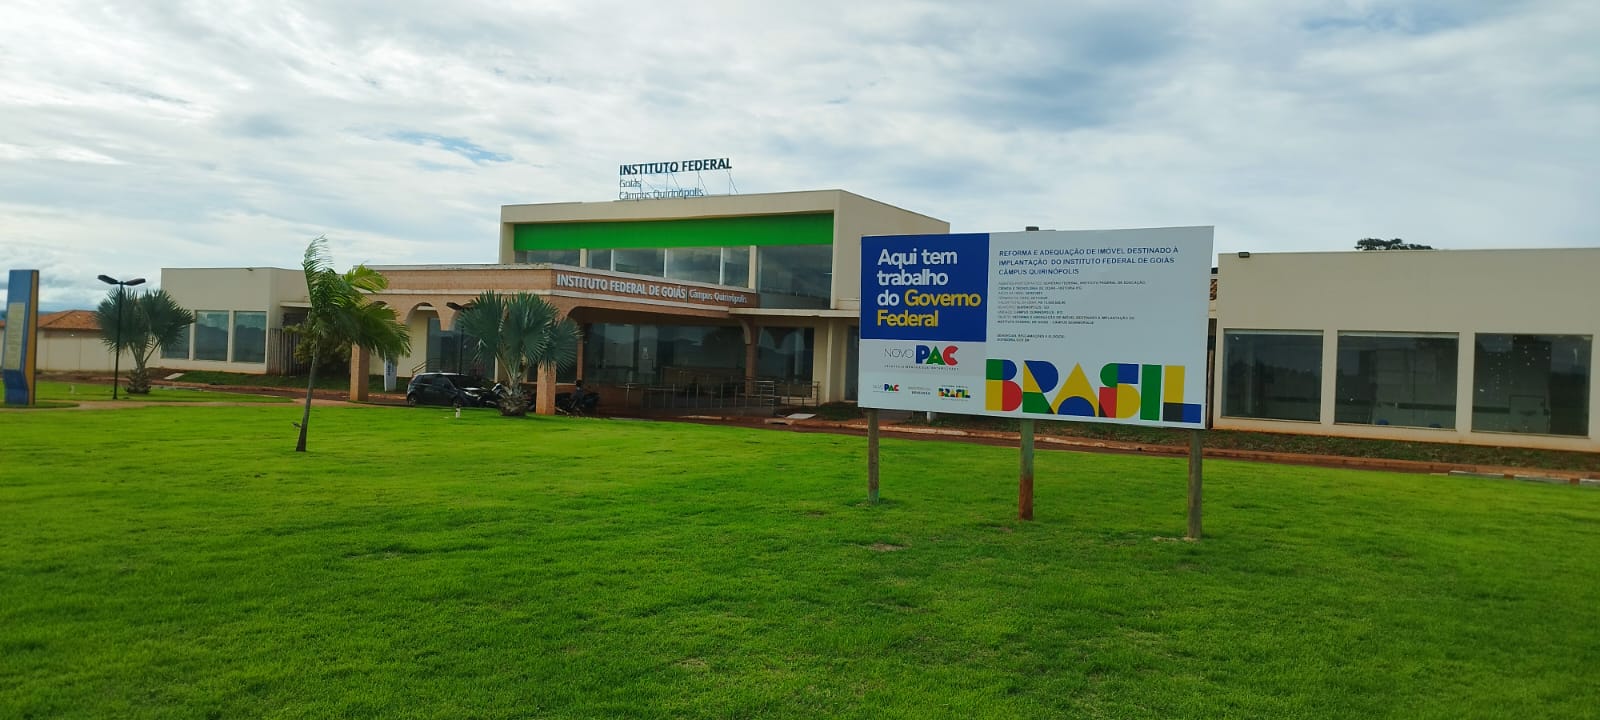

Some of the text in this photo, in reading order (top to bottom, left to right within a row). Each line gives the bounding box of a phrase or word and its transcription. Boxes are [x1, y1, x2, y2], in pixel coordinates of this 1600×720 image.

[619, 158, 732, 175] INSTITUTO FEDERAL
[877, 248, 958, 270] Aqui tem
[1039, 248, 1085, 256] ADEQUAÇÃO
[1149, 256, 1176, 264] GOIÁS
[877, 268, 949, 286] trabalho
[556, 274, 687, 299] INSTITUTO FEDERAL DE GOIÁS
[877, 289, 982, 307] do Governo
[877, 309, 939, 327] Federal
[915, 345, 959, 366] PAC
[884, 383, 900, 392] PAC
[985, 358, 1202, 424] BRASIL
